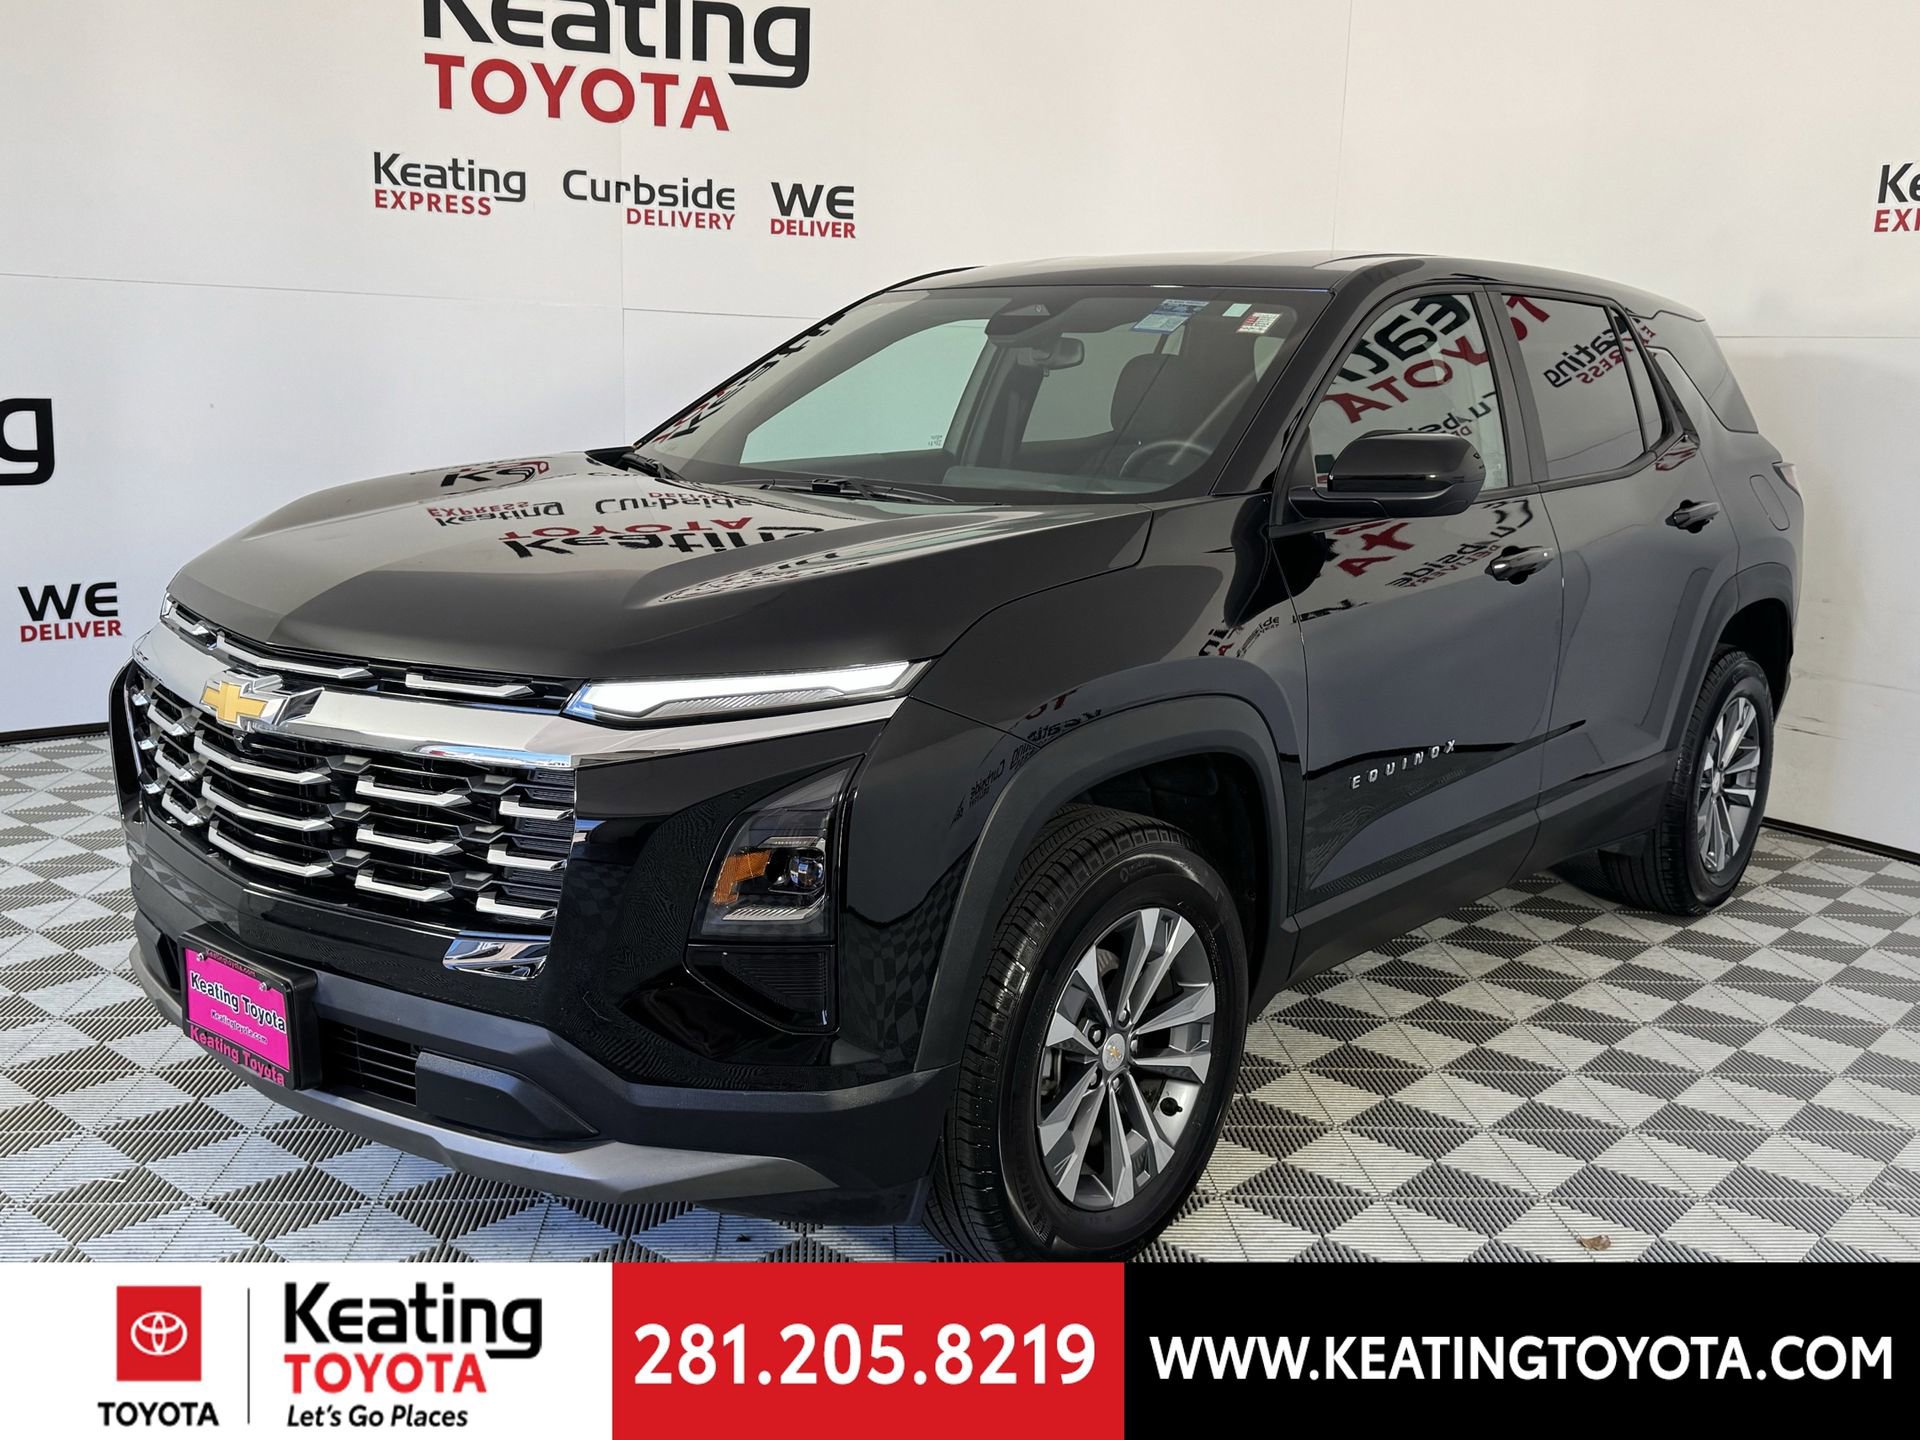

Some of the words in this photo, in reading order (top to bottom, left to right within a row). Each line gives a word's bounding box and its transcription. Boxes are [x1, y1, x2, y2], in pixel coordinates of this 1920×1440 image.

[423, 0, 811, 89] Keating
[424, 53, 730, 132] TOYOTA
[373, 151, 527, 203] Keating
[562, 169, 736, 210] Curbside
[374, 189, 492, 216] EXPRESS
[626, 207, 736, 231] DELIVERY
[770, 181, 855, 220] WE
[770, 218, 856, 239] DELIVER
[18, 581, 118, 622] WE
[20, 619, 123, 643] DELIVER
[1351, 739, 1456, 790] EQUINOX
[190, 971, 240, 1014] Keating
[241, 995, 286, 1034] Toyota
[190, 1025, 239, 1064] Keating
[242, 1052, 285, 1086] Toyota
